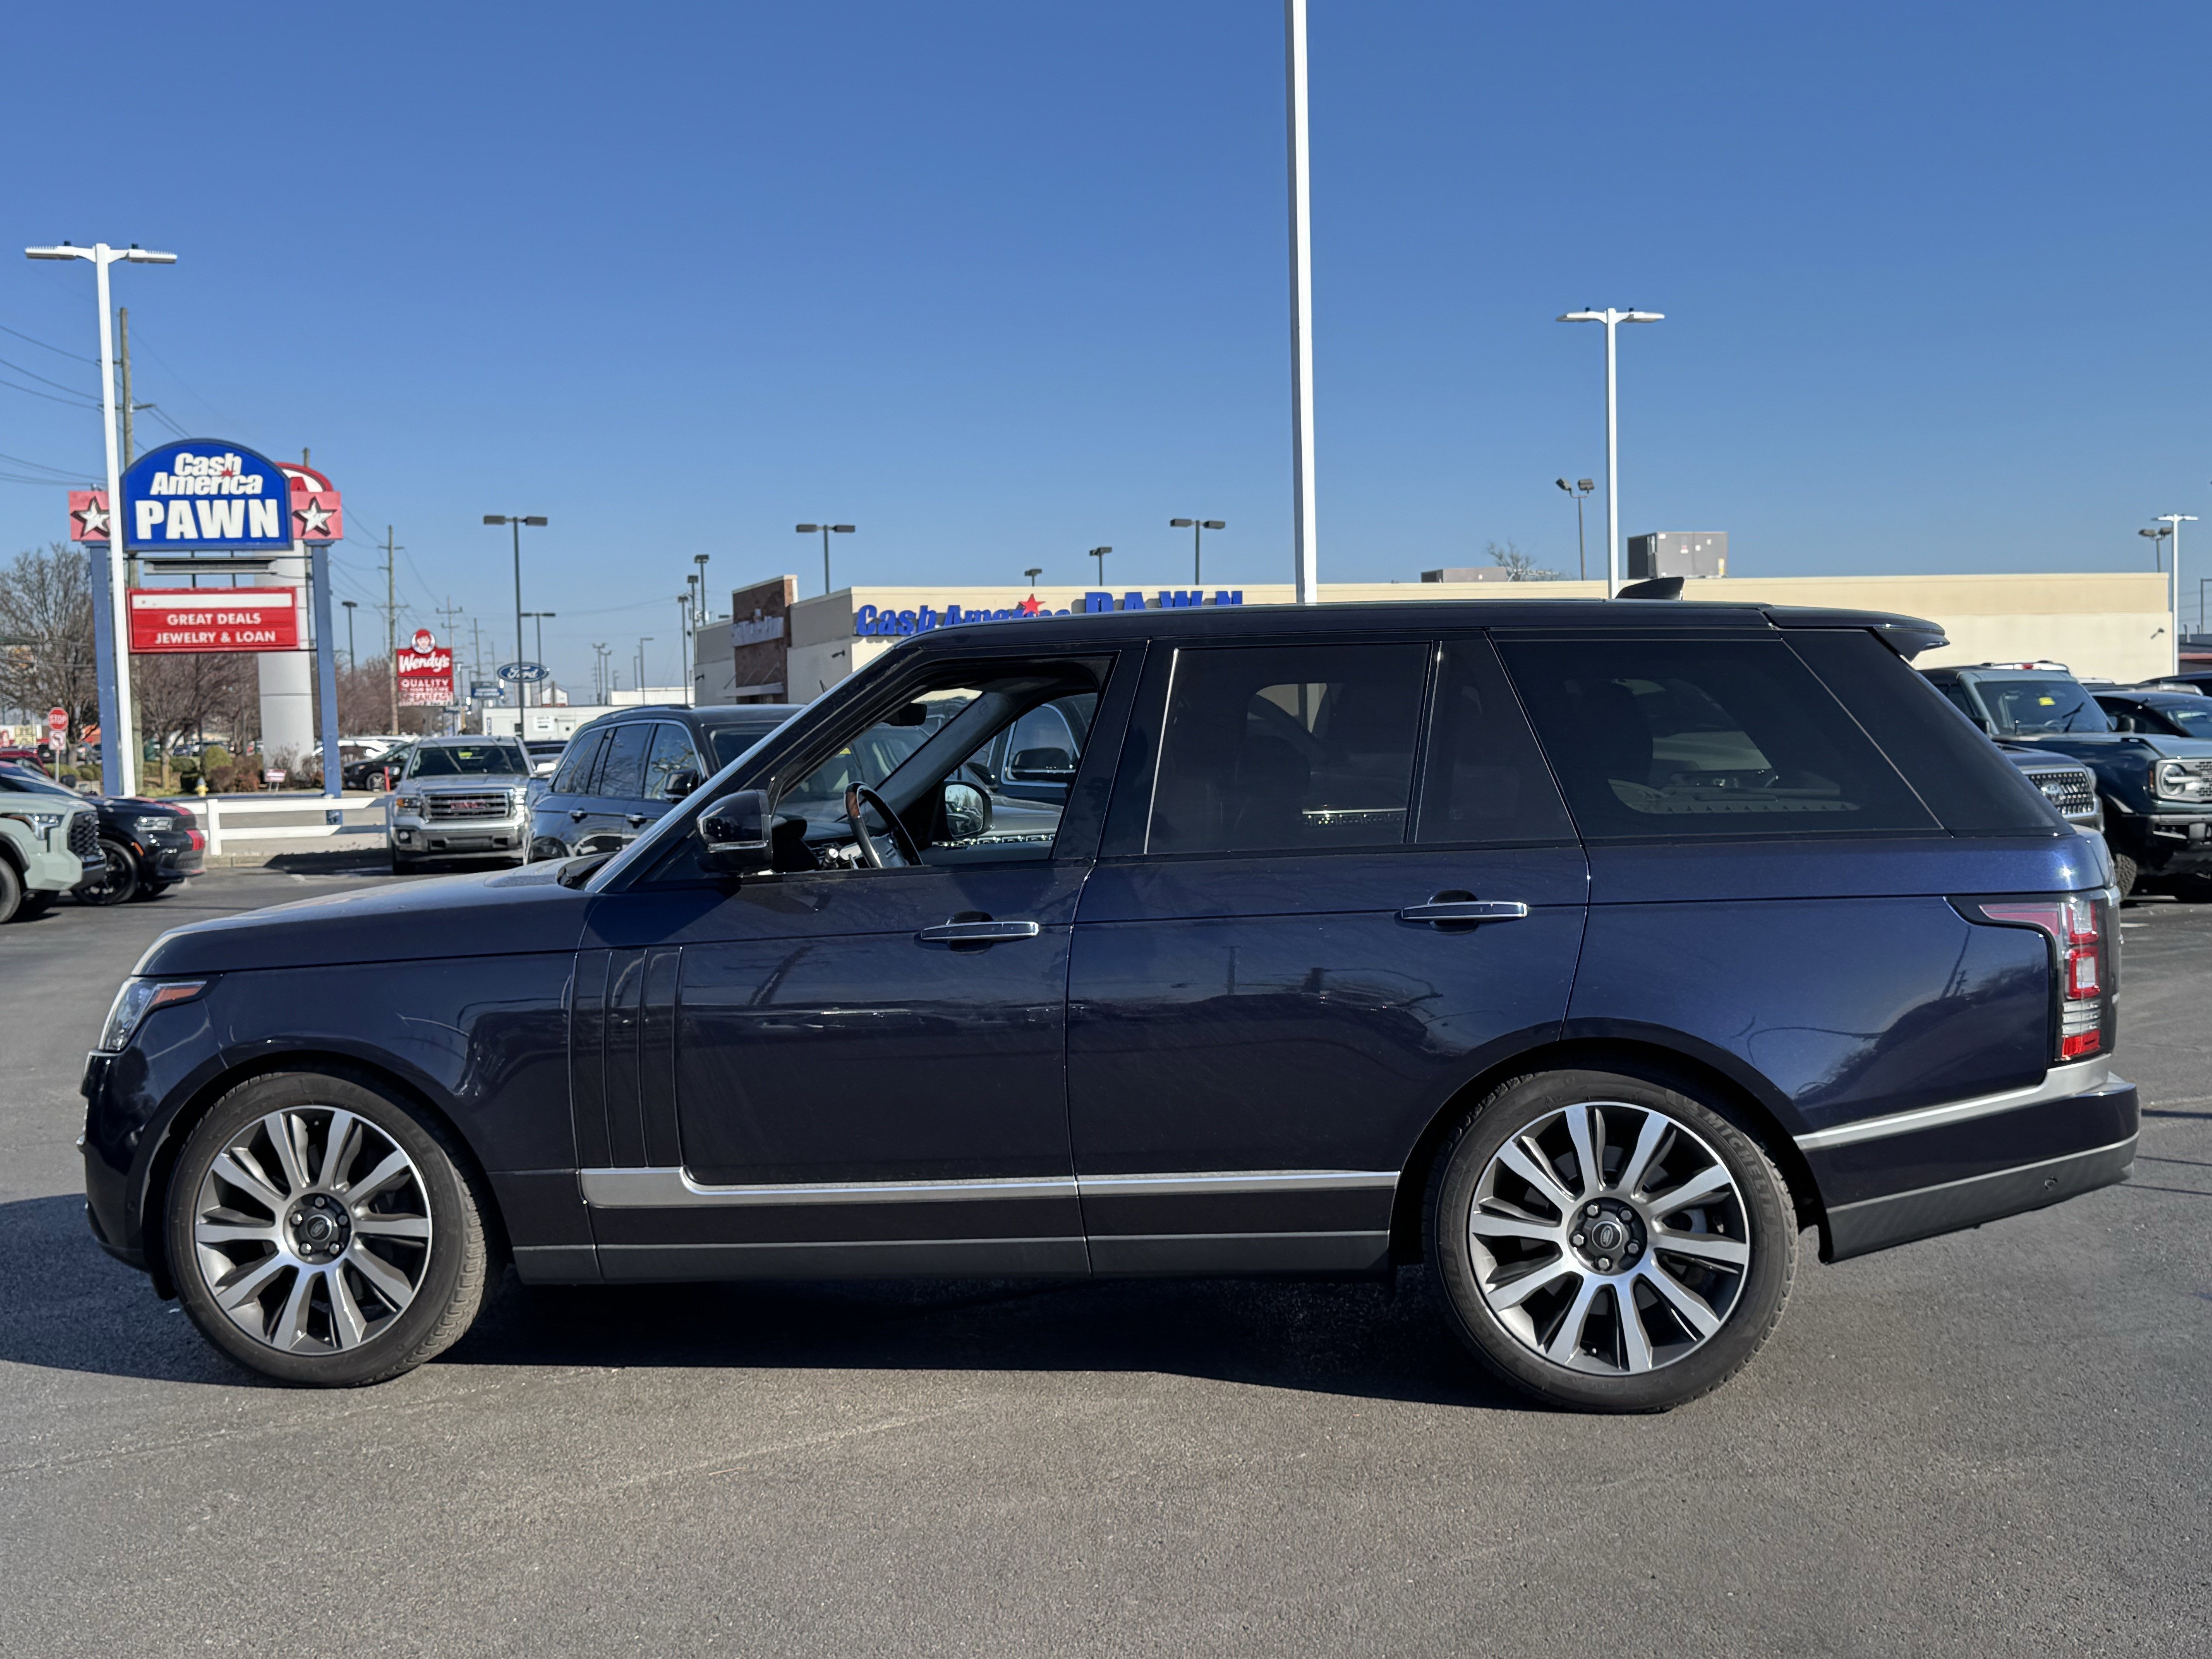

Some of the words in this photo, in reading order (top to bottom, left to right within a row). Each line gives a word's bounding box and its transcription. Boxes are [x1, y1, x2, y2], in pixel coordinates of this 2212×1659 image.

[174, 452, 242, 476] Cash
[149, 472, 263, 495] America
[135, 499, 280, 539] PAWN
[167, 613, 213, 626] GREAT
[217, 612, 262, 625] DEALS
[855, 604, 938, 636] Cash
[155, 631, 216, 644] JEWELRY
[220, 631, 231, 643] &
[235, 630, 276, 643] LOAN
[398, 651, 450, 673] Wendy's
[401, 678, 449, 687] QUALITY
[49, 714, 66, 725] STOP
[1704, 1112, 1777, 1220] MICHELIN
